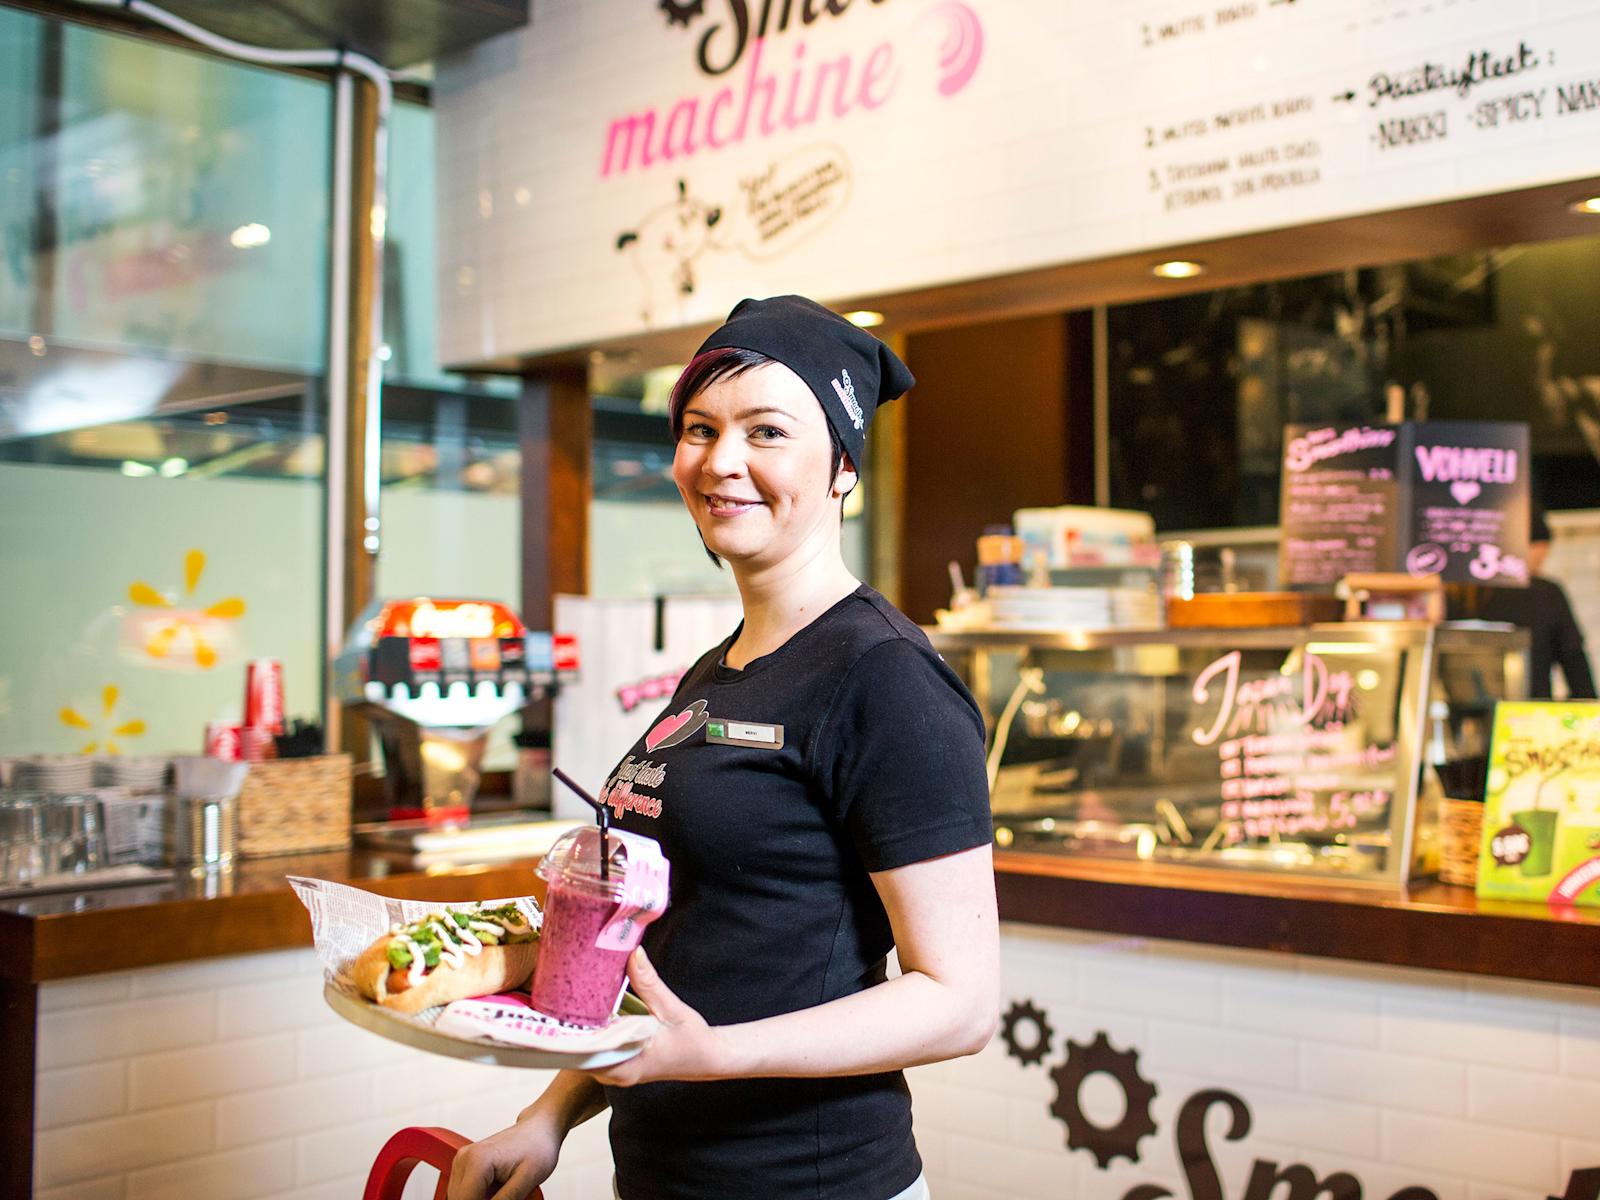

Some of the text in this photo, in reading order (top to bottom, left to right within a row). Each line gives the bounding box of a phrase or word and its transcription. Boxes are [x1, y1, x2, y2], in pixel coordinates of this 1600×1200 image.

[600, 36, 902, 178] machine
[608, 755, 668, 789] Just taste
[607, 780, 663, 820] difference
